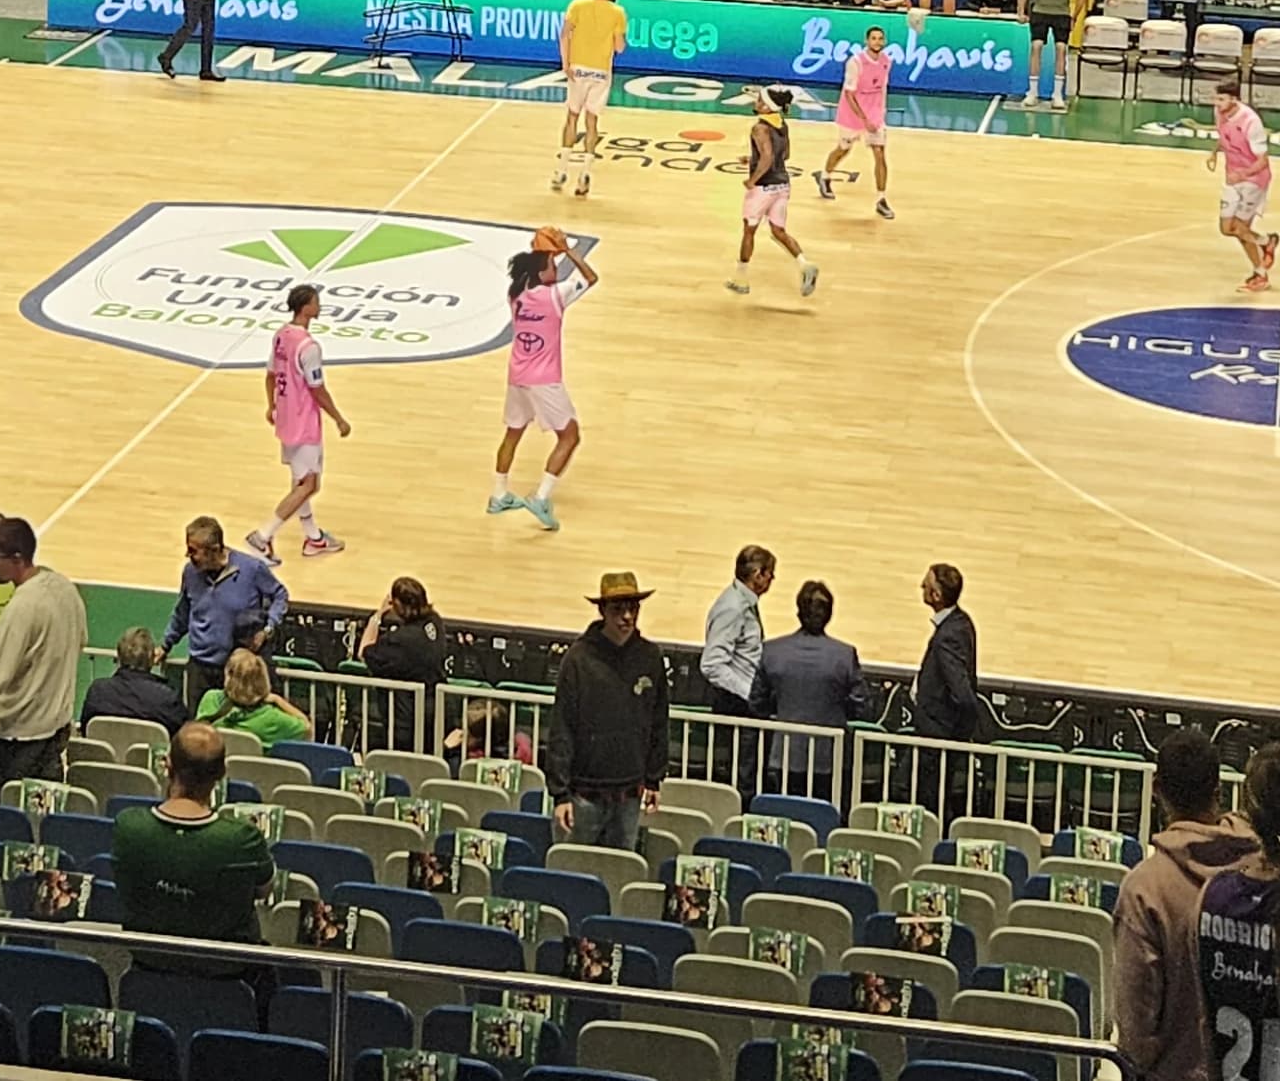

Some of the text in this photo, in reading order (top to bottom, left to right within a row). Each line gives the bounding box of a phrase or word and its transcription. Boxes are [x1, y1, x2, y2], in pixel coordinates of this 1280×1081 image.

[480, 5, 566, 41] PROVIN
[625, 18, 718, 61] uega
[137, 266, 460, 308] Fundción
[1200, 911, 1271, 951] RODRIG
[1212, 951, 1274, 991] Benaha
